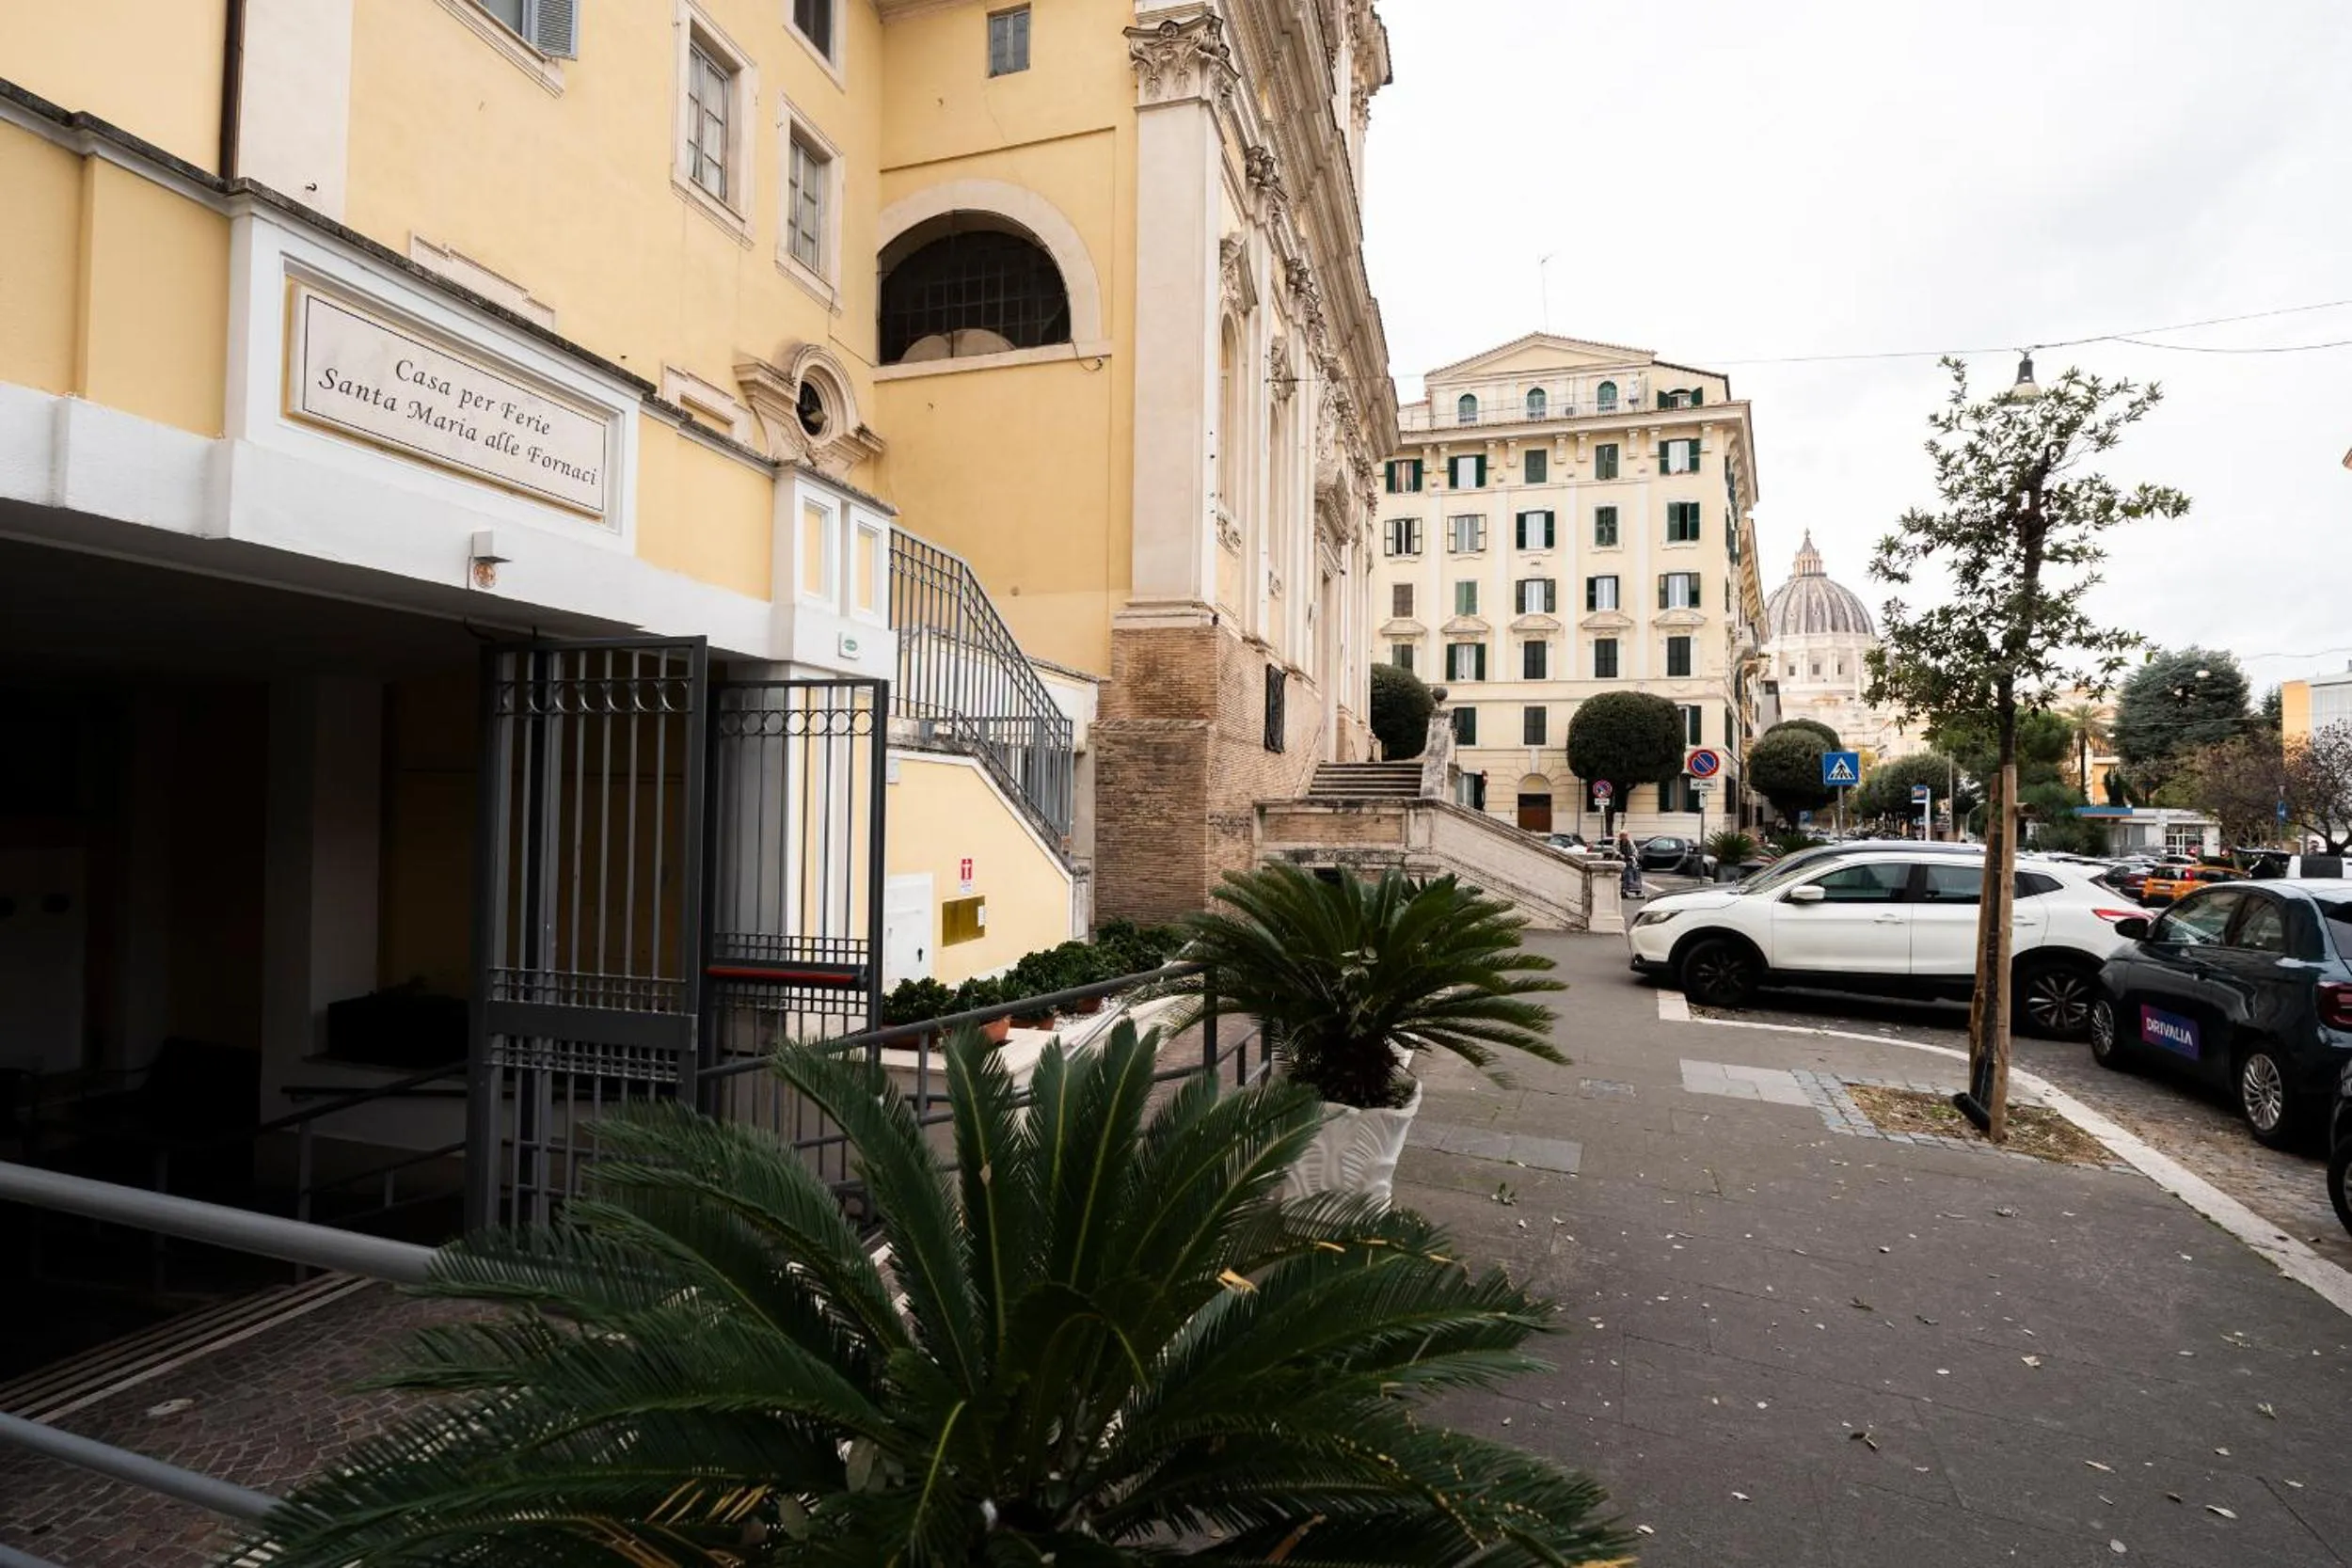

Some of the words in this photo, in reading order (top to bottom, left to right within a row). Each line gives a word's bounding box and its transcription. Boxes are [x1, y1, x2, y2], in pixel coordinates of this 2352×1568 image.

[318, 368, 397, 411] Santa
[407, 401, 477, 441] Maria
[485, 431, 519, 456] alle
[527, 446, 597, 485] Fornaci
[396, 359, 451, 395] Casa
[458, 388, 496, 414] per
[501, 402, 550, 436] Ferie
[2146, 1017, 2193, 1046] DRIVALIA
